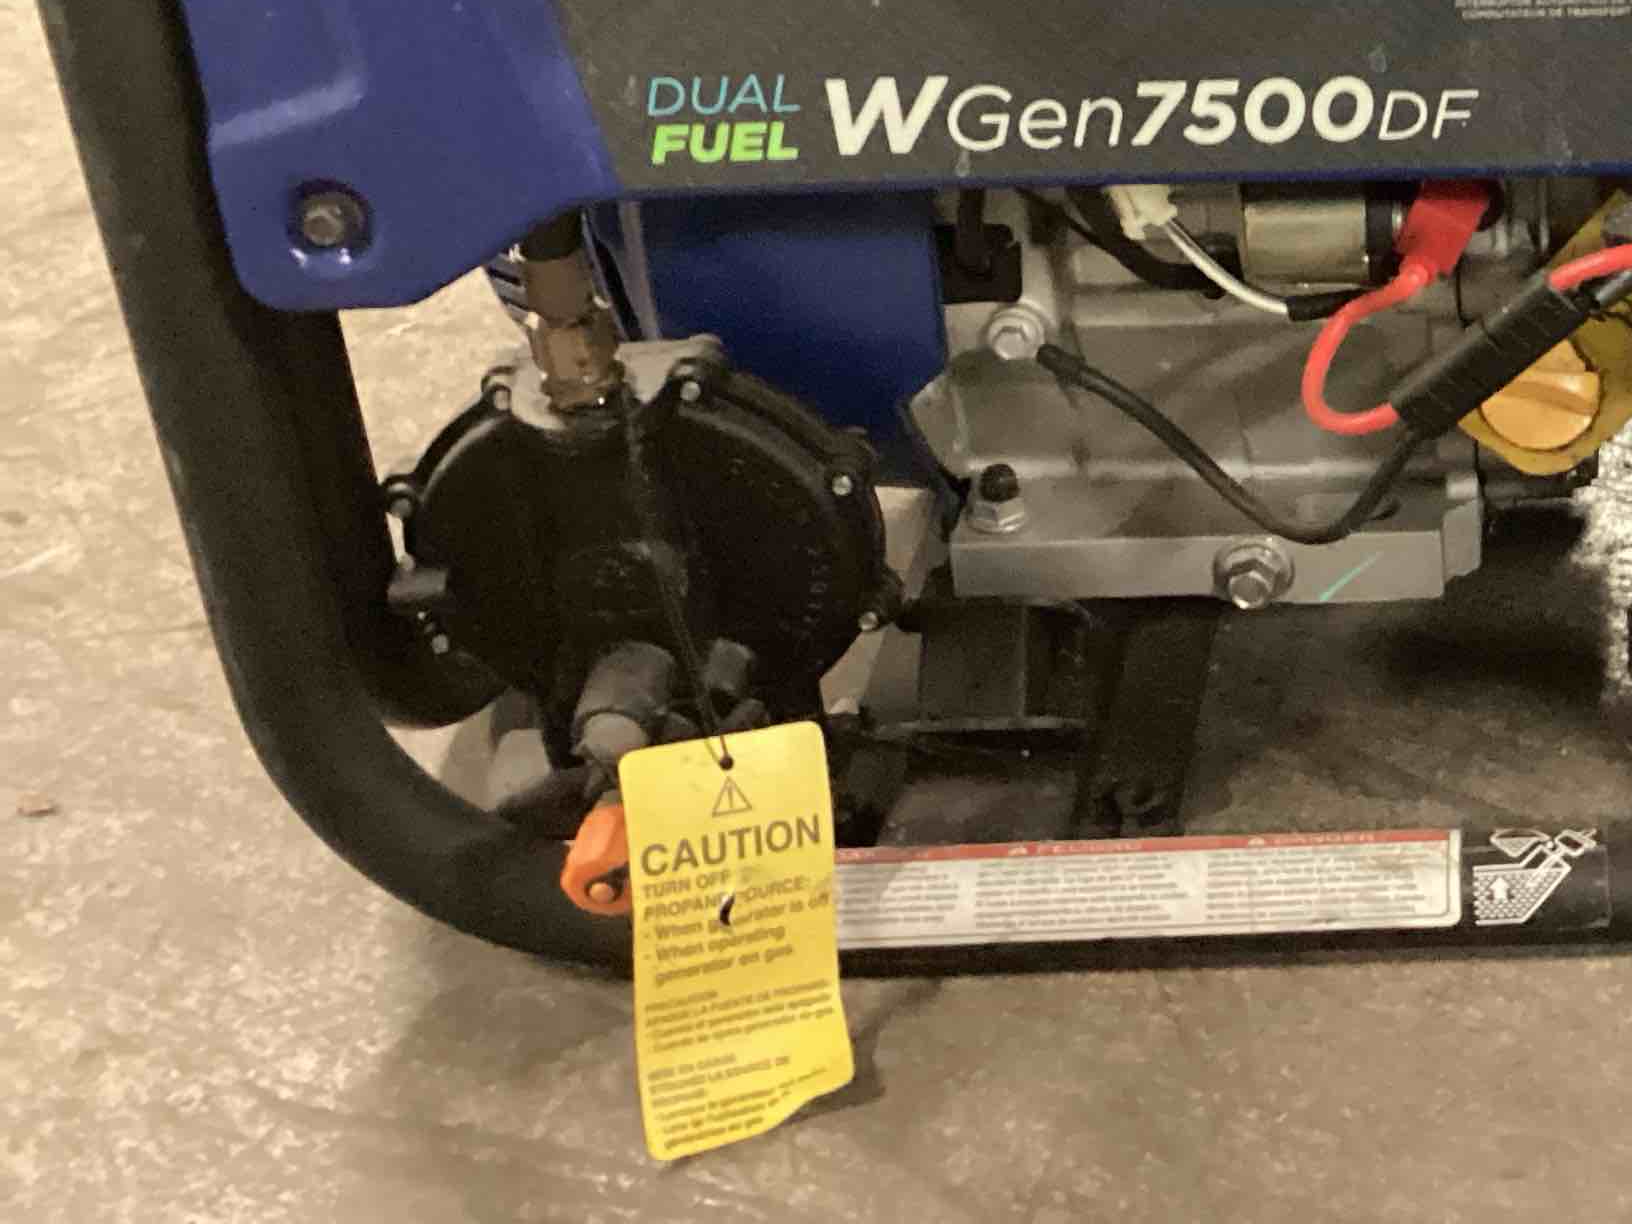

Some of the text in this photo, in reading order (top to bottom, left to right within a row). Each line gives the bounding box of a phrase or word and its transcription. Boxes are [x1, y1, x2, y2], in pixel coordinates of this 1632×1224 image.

[647, 73, 801, 117] DUAL
[651, 120, 800, 166] FUEL
[641, 813, 821, 877] CAUTION
[643, 879, 691, 900] TURN
[695, 868, 732, 890] OFF
